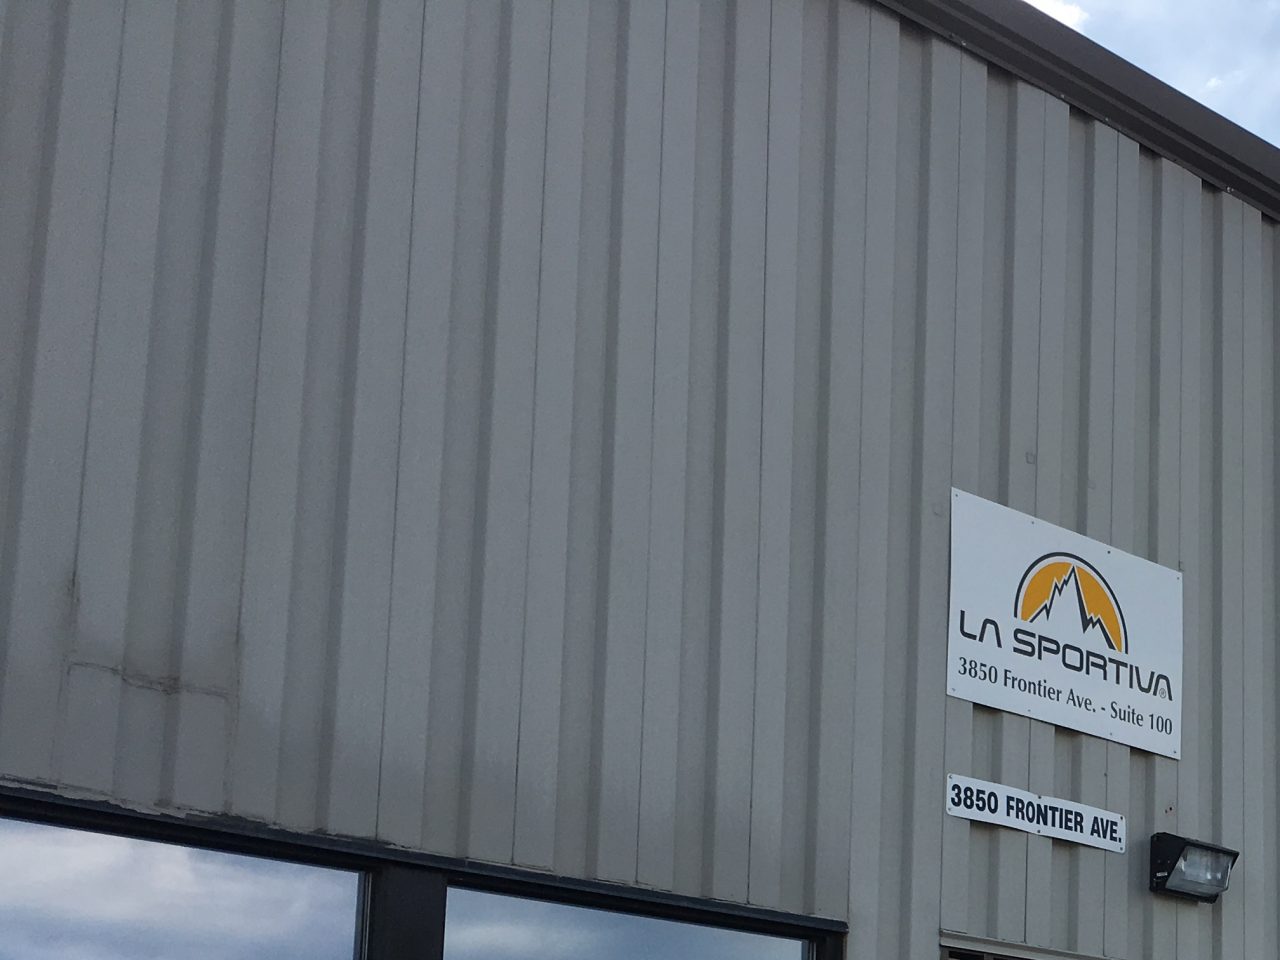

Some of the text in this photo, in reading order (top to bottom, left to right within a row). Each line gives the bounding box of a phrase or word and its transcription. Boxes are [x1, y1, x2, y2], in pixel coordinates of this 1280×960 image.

[960, 609, 1173, 702] LA SPORTIVA
[957, 656, 998, 684] 3850
[1003, 669, 1062, 702] Frontier
[1066, 688, 1097, 713] Ave.
[1110, 701, 1144, 727] Suite
[1149, 713, 1173, 735] 100
[950, 783, 1122, 843] 3850 FRONTIER AVE.
